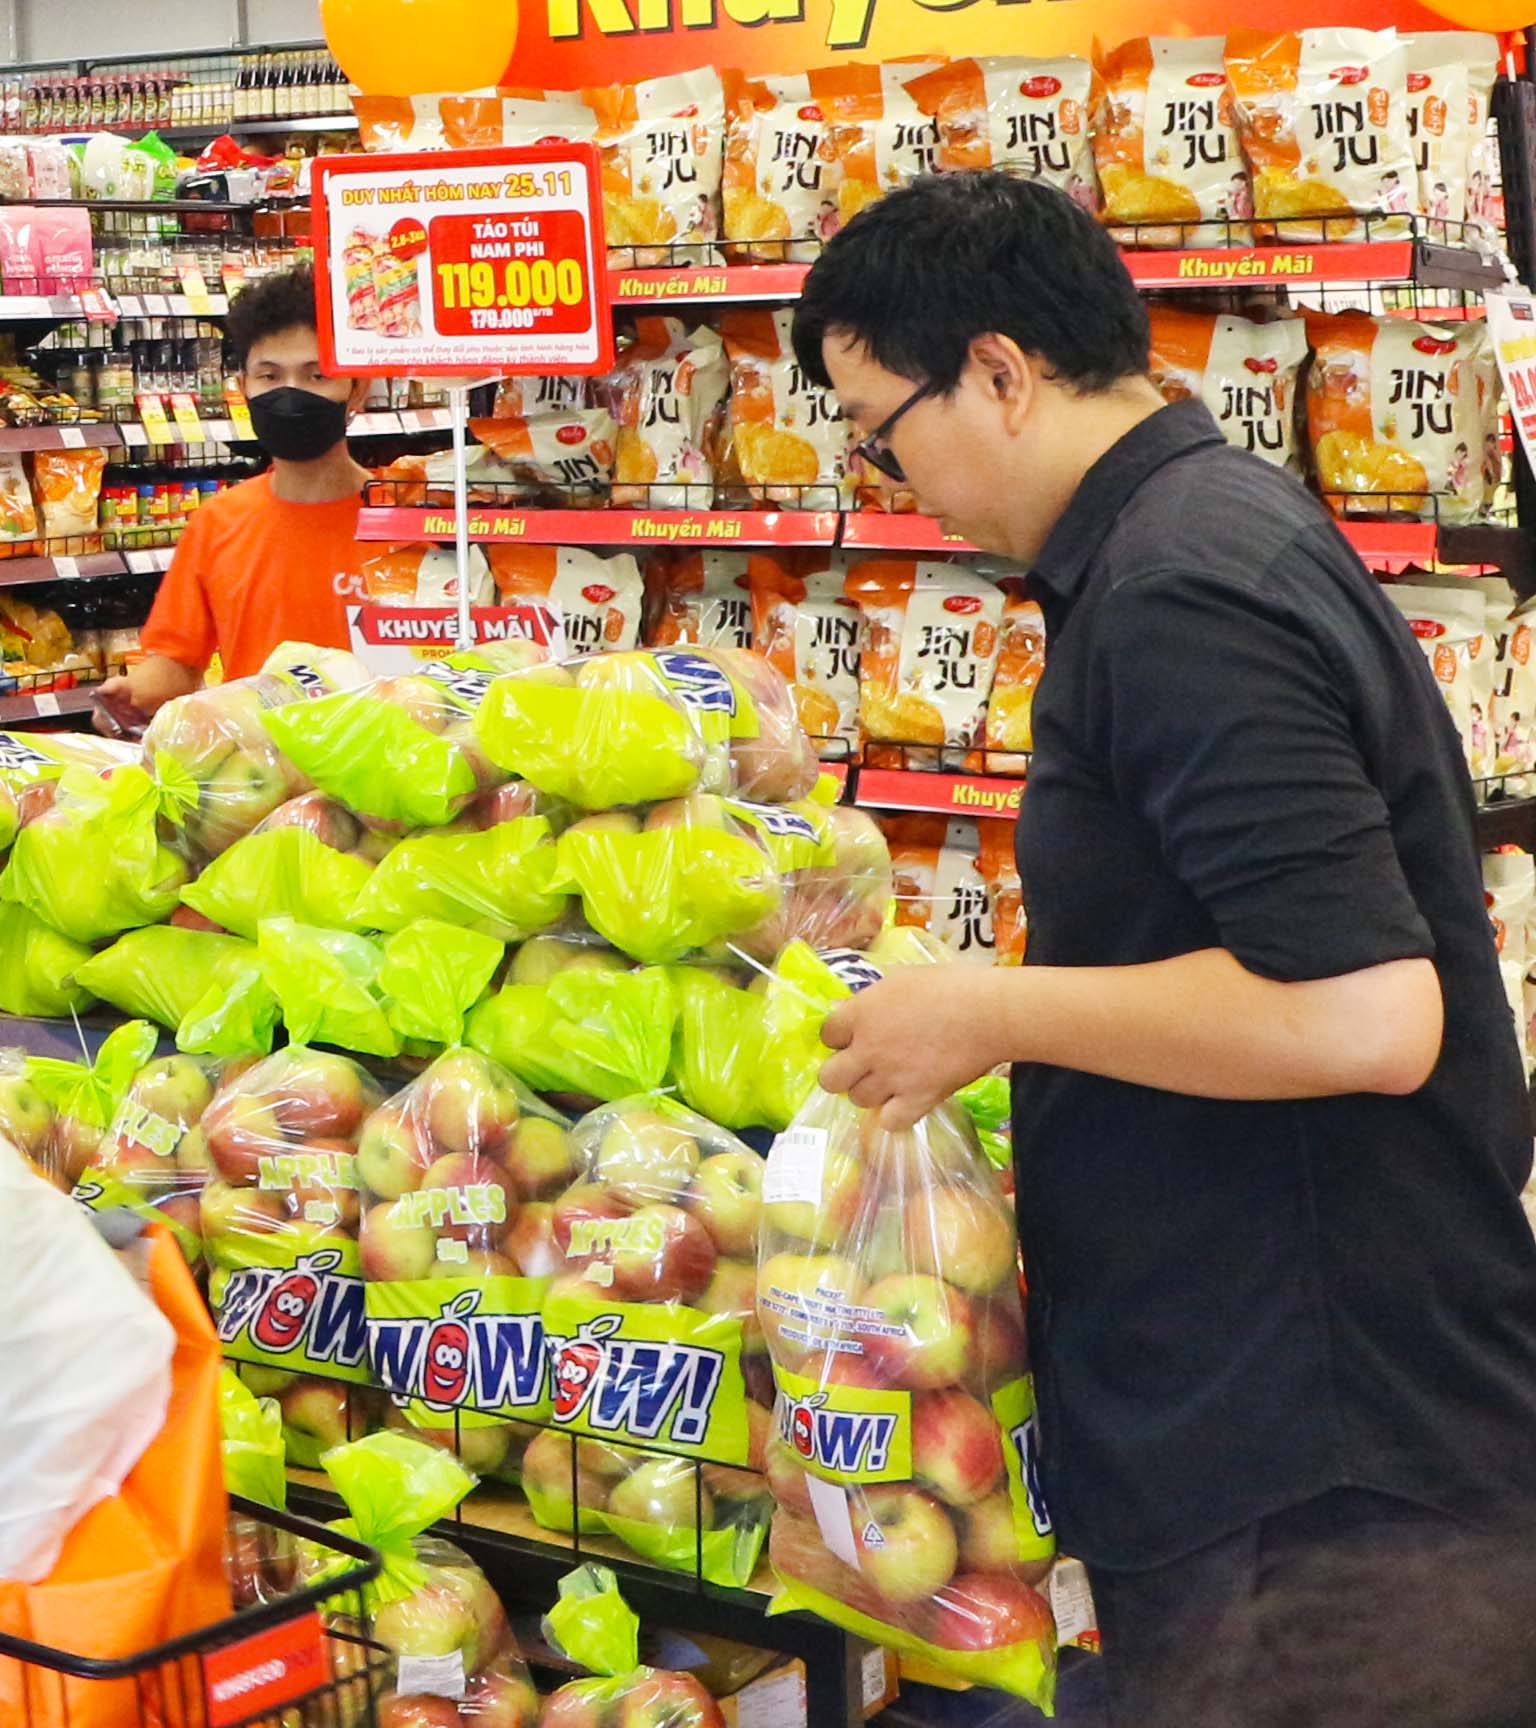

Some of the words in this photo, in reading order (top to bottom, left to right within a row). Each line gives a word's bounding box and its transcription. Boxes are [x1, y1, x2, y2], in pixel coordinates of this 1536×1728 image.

[1006, 112, 1056, 149] JIN
[1162, 100, 1214, 136] JIN
[1312, 100, 1364, 139] JIN
[646, 130, 689, 163] JIN
[771, 131, 819, 162] JIN
[1028, 142, 1070, 177] JU
[1184, 134, 1225, 170] JU
[1334, 135, 1377, 172] JU
[342, 189, 375, 206] DUY
[378, 181, 422, 204] NHẤT
[426, 179, 464, 201] HÔM
[468, 183, 501, 199] NAY
[505, 171, 571, 198] 25.11
[663, 159, 696, 191] JU
[782, 161, 821, 191] JU
[473, 218, 507, 238] TÁO
[511, 216, 539, 237] TÚI
[471, 241, 513, 258] NAM
[515, 240, 544, 257] PHI
[1179, 253, 1264, 280] Khuyến
[1271, 254, 1313, 275] Mãi
[436, 258, 583, 309] 119.000
[619, 274, 688, 298] Khuyến
[693, 275, 726, 294] Mãi
[1220, 385, 1271, 420] JIN
[1390, 369, 1445, 404] JIN
[1242, 419, 1282, 451] JU
[1412, 403, 1452, 439] JU
[424, 515, 489, 536] Khuến
[493, 516, 525, 535] Mãi
[632, 519, 701, 540] Khuyến
[707, 520, 741, 538] Mãi
[377, 613, 477, 639] KHUYẾ
[485, 614, 534, 639] MÃI
[811, 616, 858, 647] JIN
[917, 625, 969, 658] JIN
[934, 659, 975, 690] JU
[953, 783, 1024, 811] Khuyế
[947, 887, 989, 918] JIN
[959, 919, 994, 950] JU
[391, 1183, 506, 1230] APPLES
[567, 1215, 666, 1258] APPLES
[546, 1314, 724, 1445] OW!
